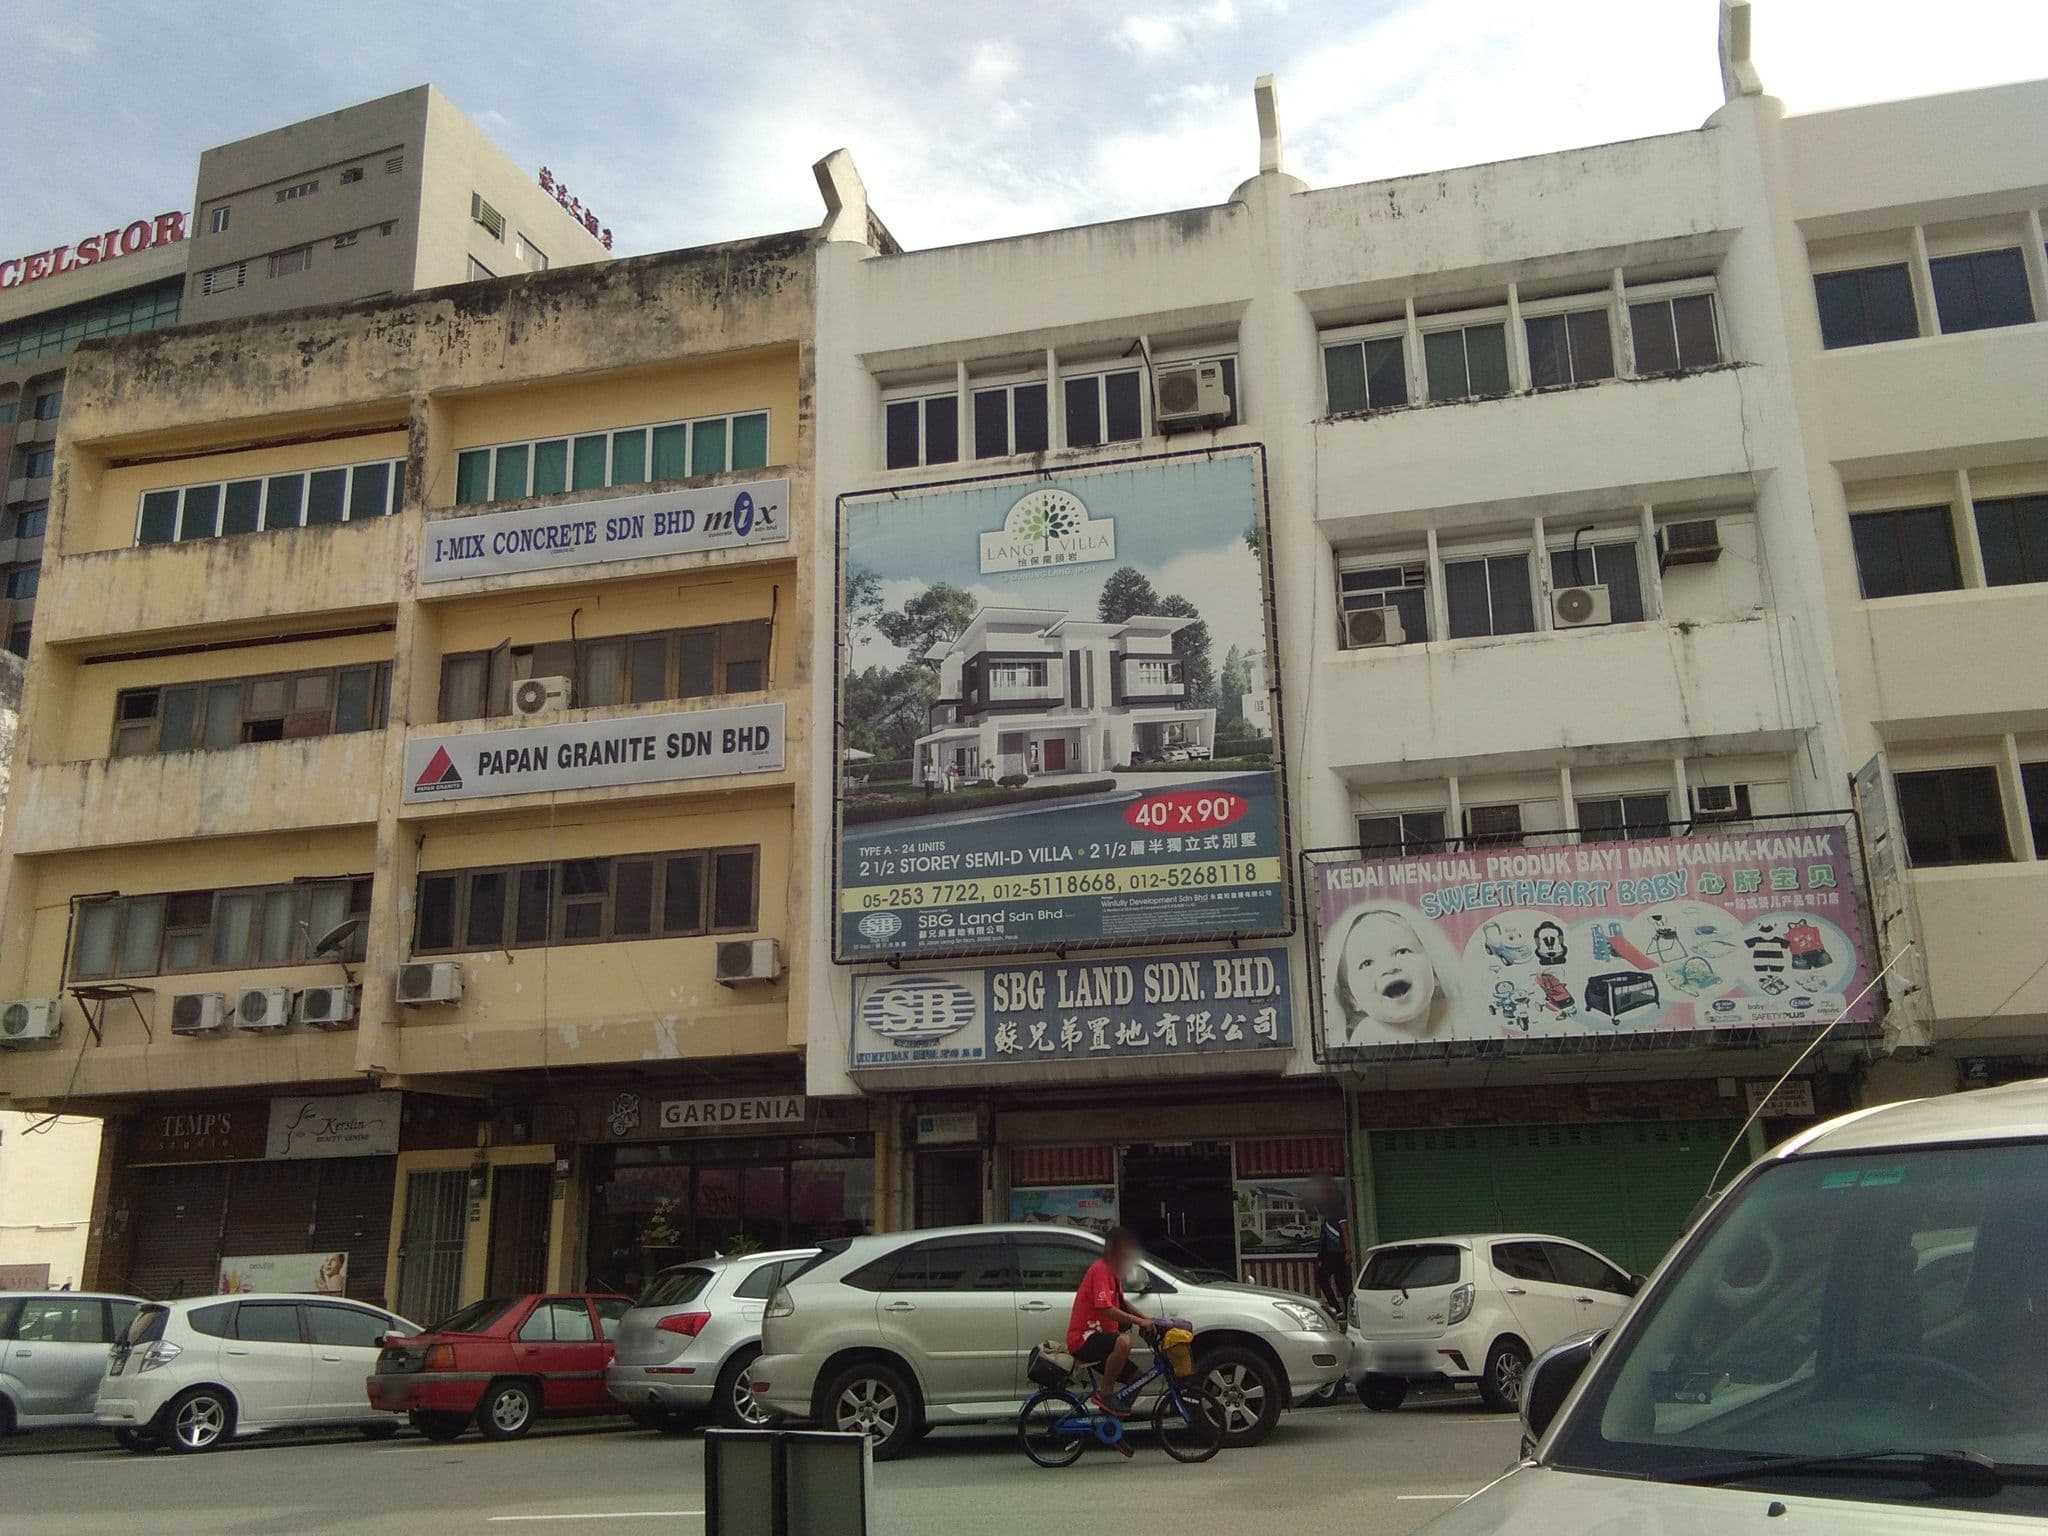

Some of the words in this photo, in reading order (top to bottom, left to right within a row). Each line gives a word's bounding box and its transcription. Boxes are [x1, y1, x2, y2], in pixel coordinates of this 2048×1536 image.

[0, 210, 187, 290] CELSIOR
[434, 533, 486, 563] I-MIX
[493, 520, 597, 556] CONCRETE
[606, 514, 645, 542] SDN
[653, 508, 695, 537] BHD
[987, 543, 1034, 560] LANG
[1059, 536, 1109, 551] VILLA
[478, 744, 548, 776] PAPAN
[557, 735, 656, 769] GRANITE
[666, 729, 712, 759] SDN
[722, 725, 770, 754] BHD
[859, 846, 881, 857] TYPE
[884, 845, 892, 855] A
[902, 843, 915, 854] 24
[918, 841, 945, 853] UNITS
[900, 854, 960, 874] STOREY
[965, 849, 1023, 868] SEMI-D
[1028, 846, 1073, 863] VILLA
[1326, 865, 1384, 890] KEDAI
[1389, 859, 1482, 886] MENJUAL
[1487, 852, 1571, 879] PRODUK
[1576, 848, 1621, 873] BAYI
[1627, 845, 1669, 867] DAN
[1676, 834, 1834, 865] KANAK-KANAK
[863, 887, 923, 909] 05-253
[933, 882, 985, 904] 7722,
[993, 873, 1122, 899] 012-5118668,
[1130, 863, 1257, 889] 012-5268118
[1420, 879, 1611, 920] SWEETHEART
[1616, 868, 1688, 906] BABY
[918, 914, 953, 929] SBG
[959, 910, 1005, 926] Land
[1009, 911, 1034, 922] Sdn
[1038, 909, 1063, 921] Bhd
[993, 970, 1045, 1012] SBG
[1057, 965, 1133, 1009] LAND
[1144, 960, 1205, 1003] SDN.
[1213, 956, 1281, 999] BHD.
[162, 1112, 232, 1138] TEMP'S
[665, 1100, 801, 1124] GARDENIA
